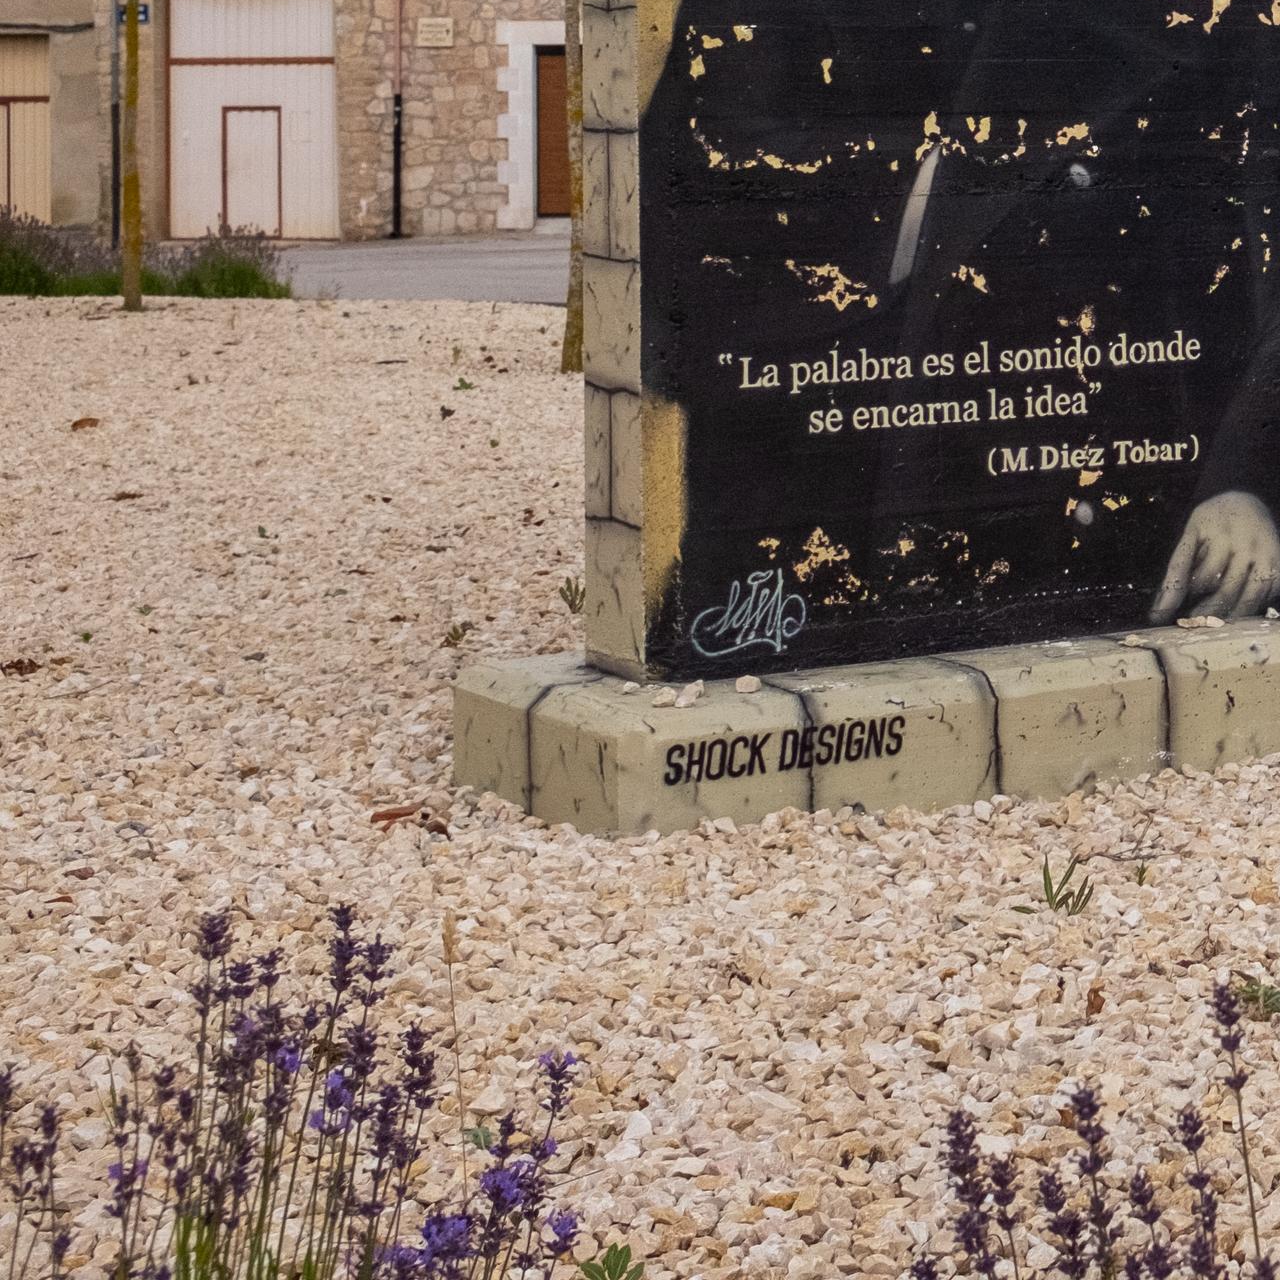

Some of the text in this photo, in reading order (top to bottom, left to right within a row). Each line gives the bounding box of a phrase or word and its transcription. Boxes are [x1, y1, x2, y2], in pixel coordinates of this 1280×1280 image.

[790, 348, 913, 394] palabra
[922, 353, 954, 376] es
[964, 341, 991, 374] el
[1000, 336, 1101, 372] sonido
[1109, 330, 1200, 366] donde
[809, 408, 843, 434] se
[853, 400, 980, 430] encarna
[988, 389, 1020, 420] la
[1113, 434, 1200, 466] Tobar)
[664, 716, 906, 786] SHOCK DESIGNS
